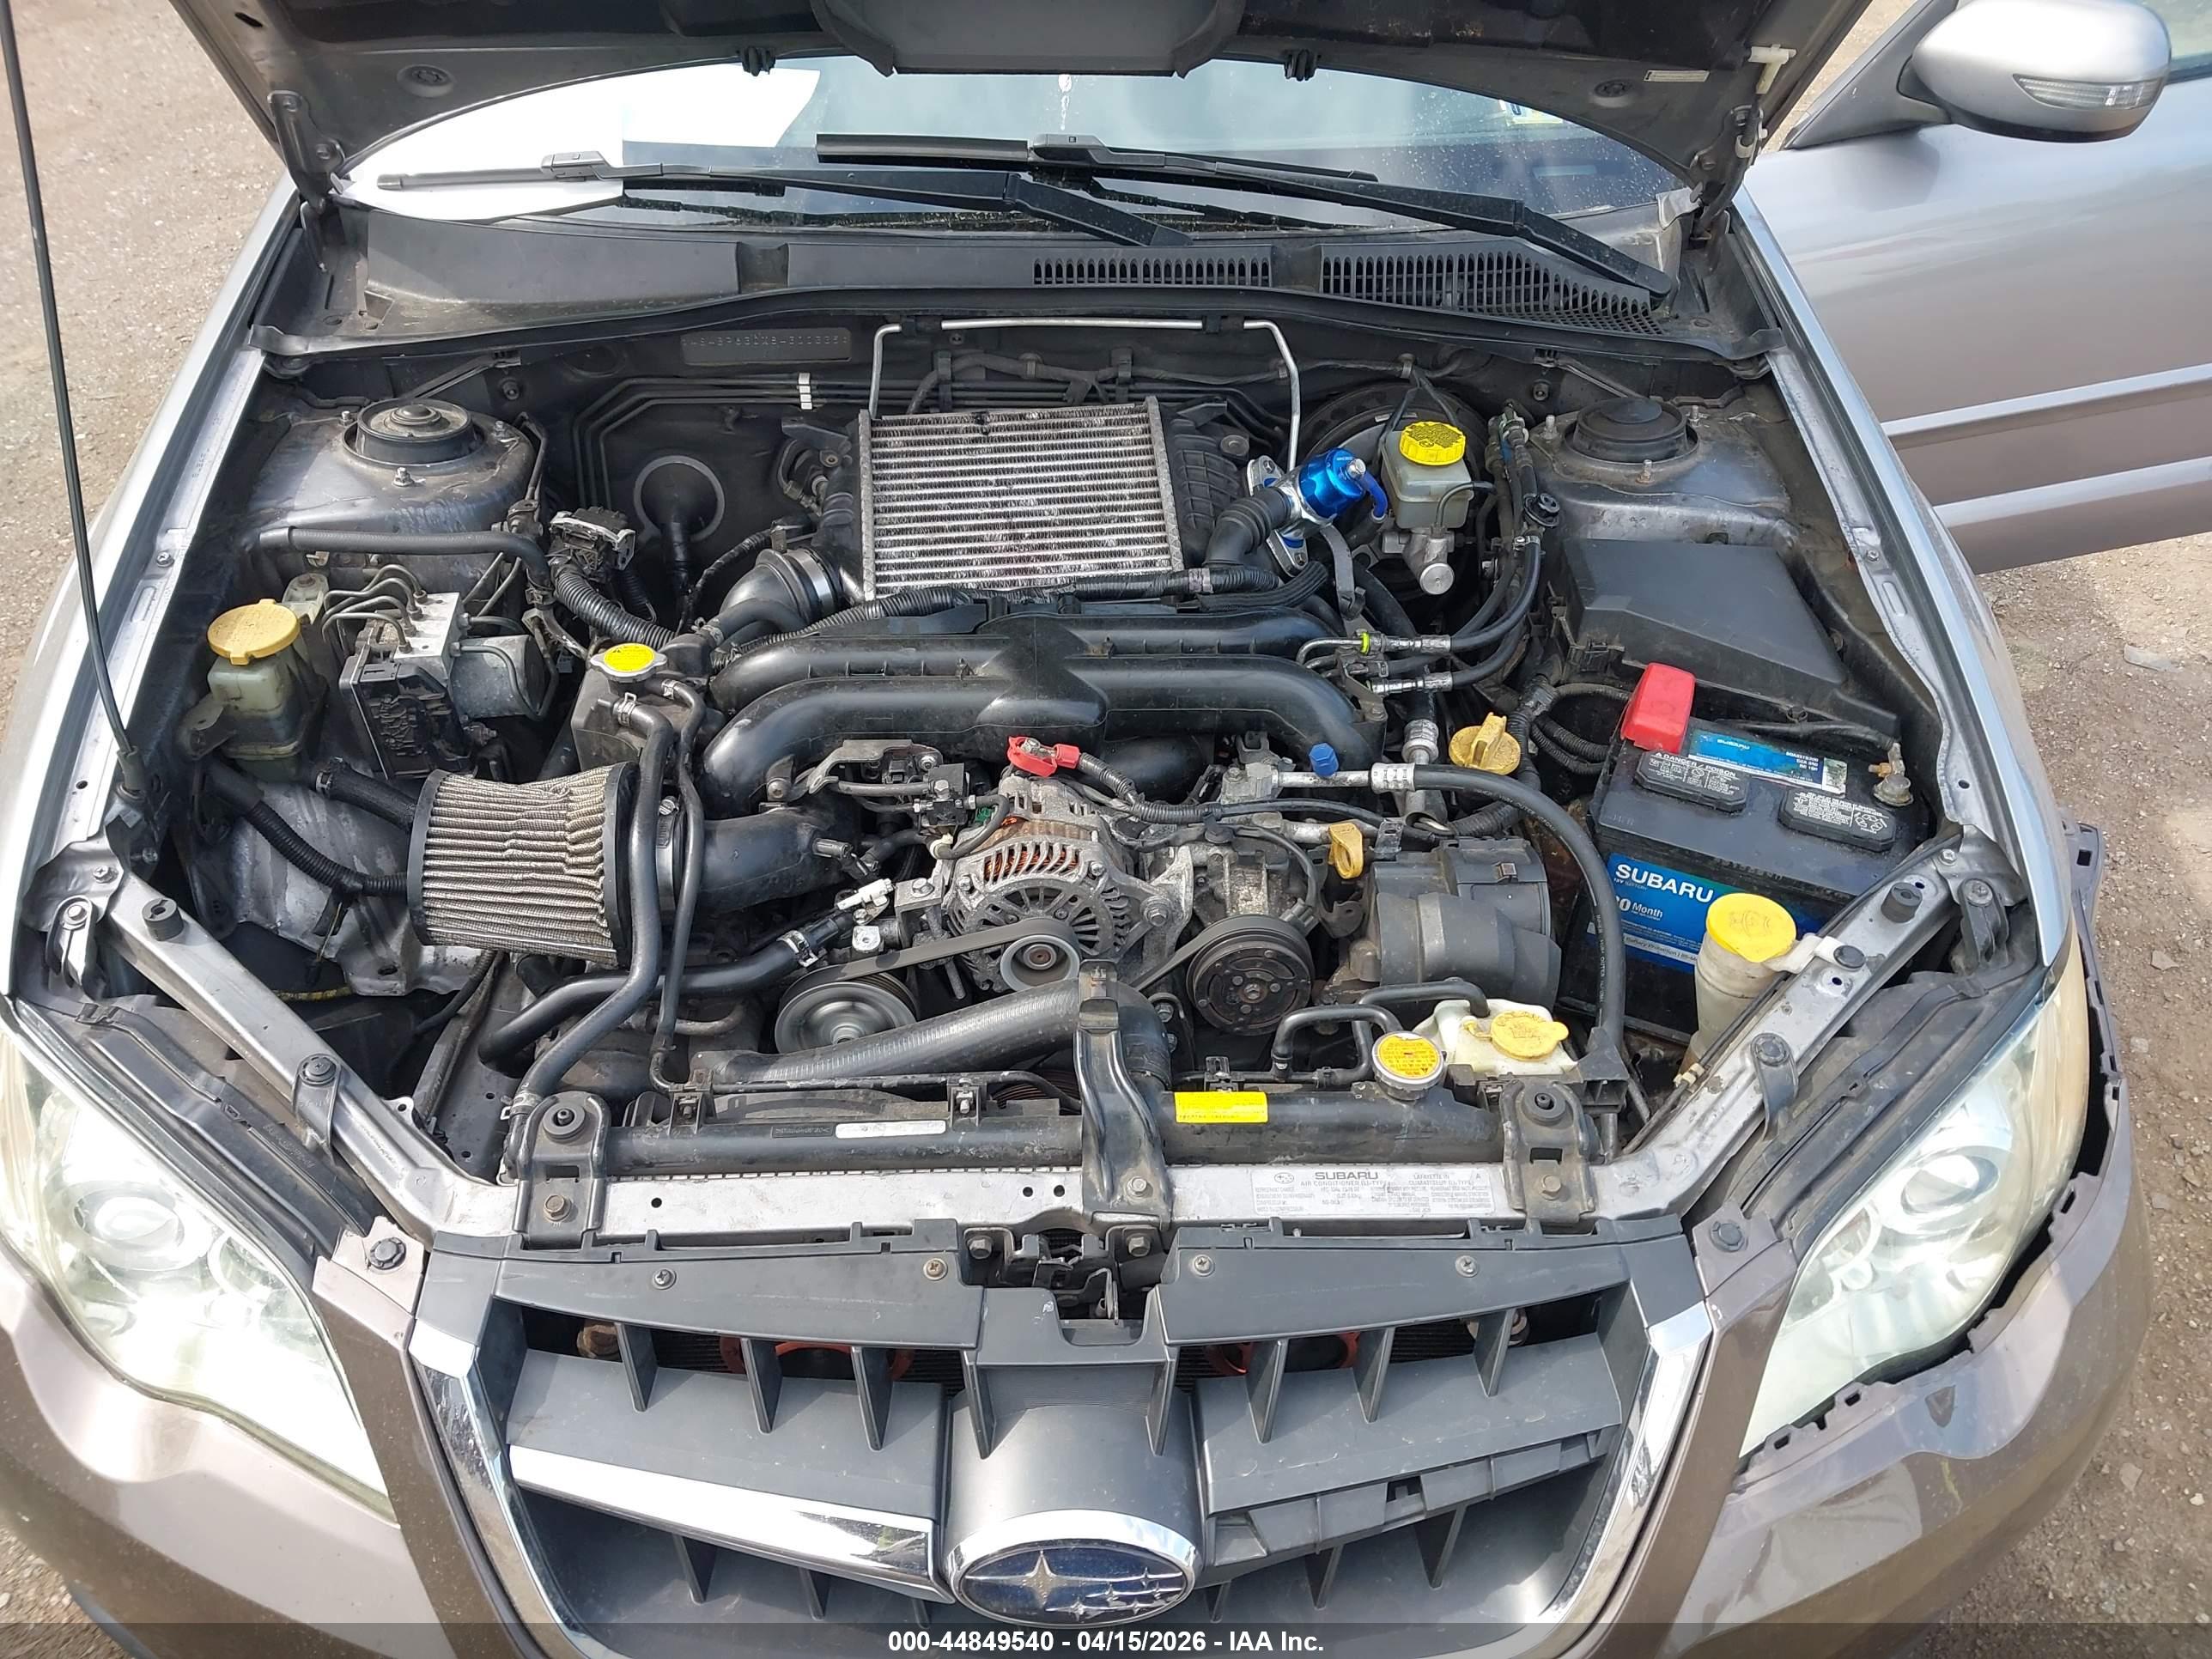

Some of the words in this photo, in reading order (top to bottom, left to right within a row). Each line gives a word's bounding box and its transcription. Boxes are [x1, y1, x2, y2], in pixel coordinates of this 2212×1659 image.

[1664, 753, 1698, 767] DANGER
[1705, 765, 1736, 777] POISON
[1615, 864, 1714, 903] SUBARU
[1632, 902, 1663, 918] Month
[1647, 941, 1678, 957] Protection
[1315, 1171, 1378, 1180] SUBARU
